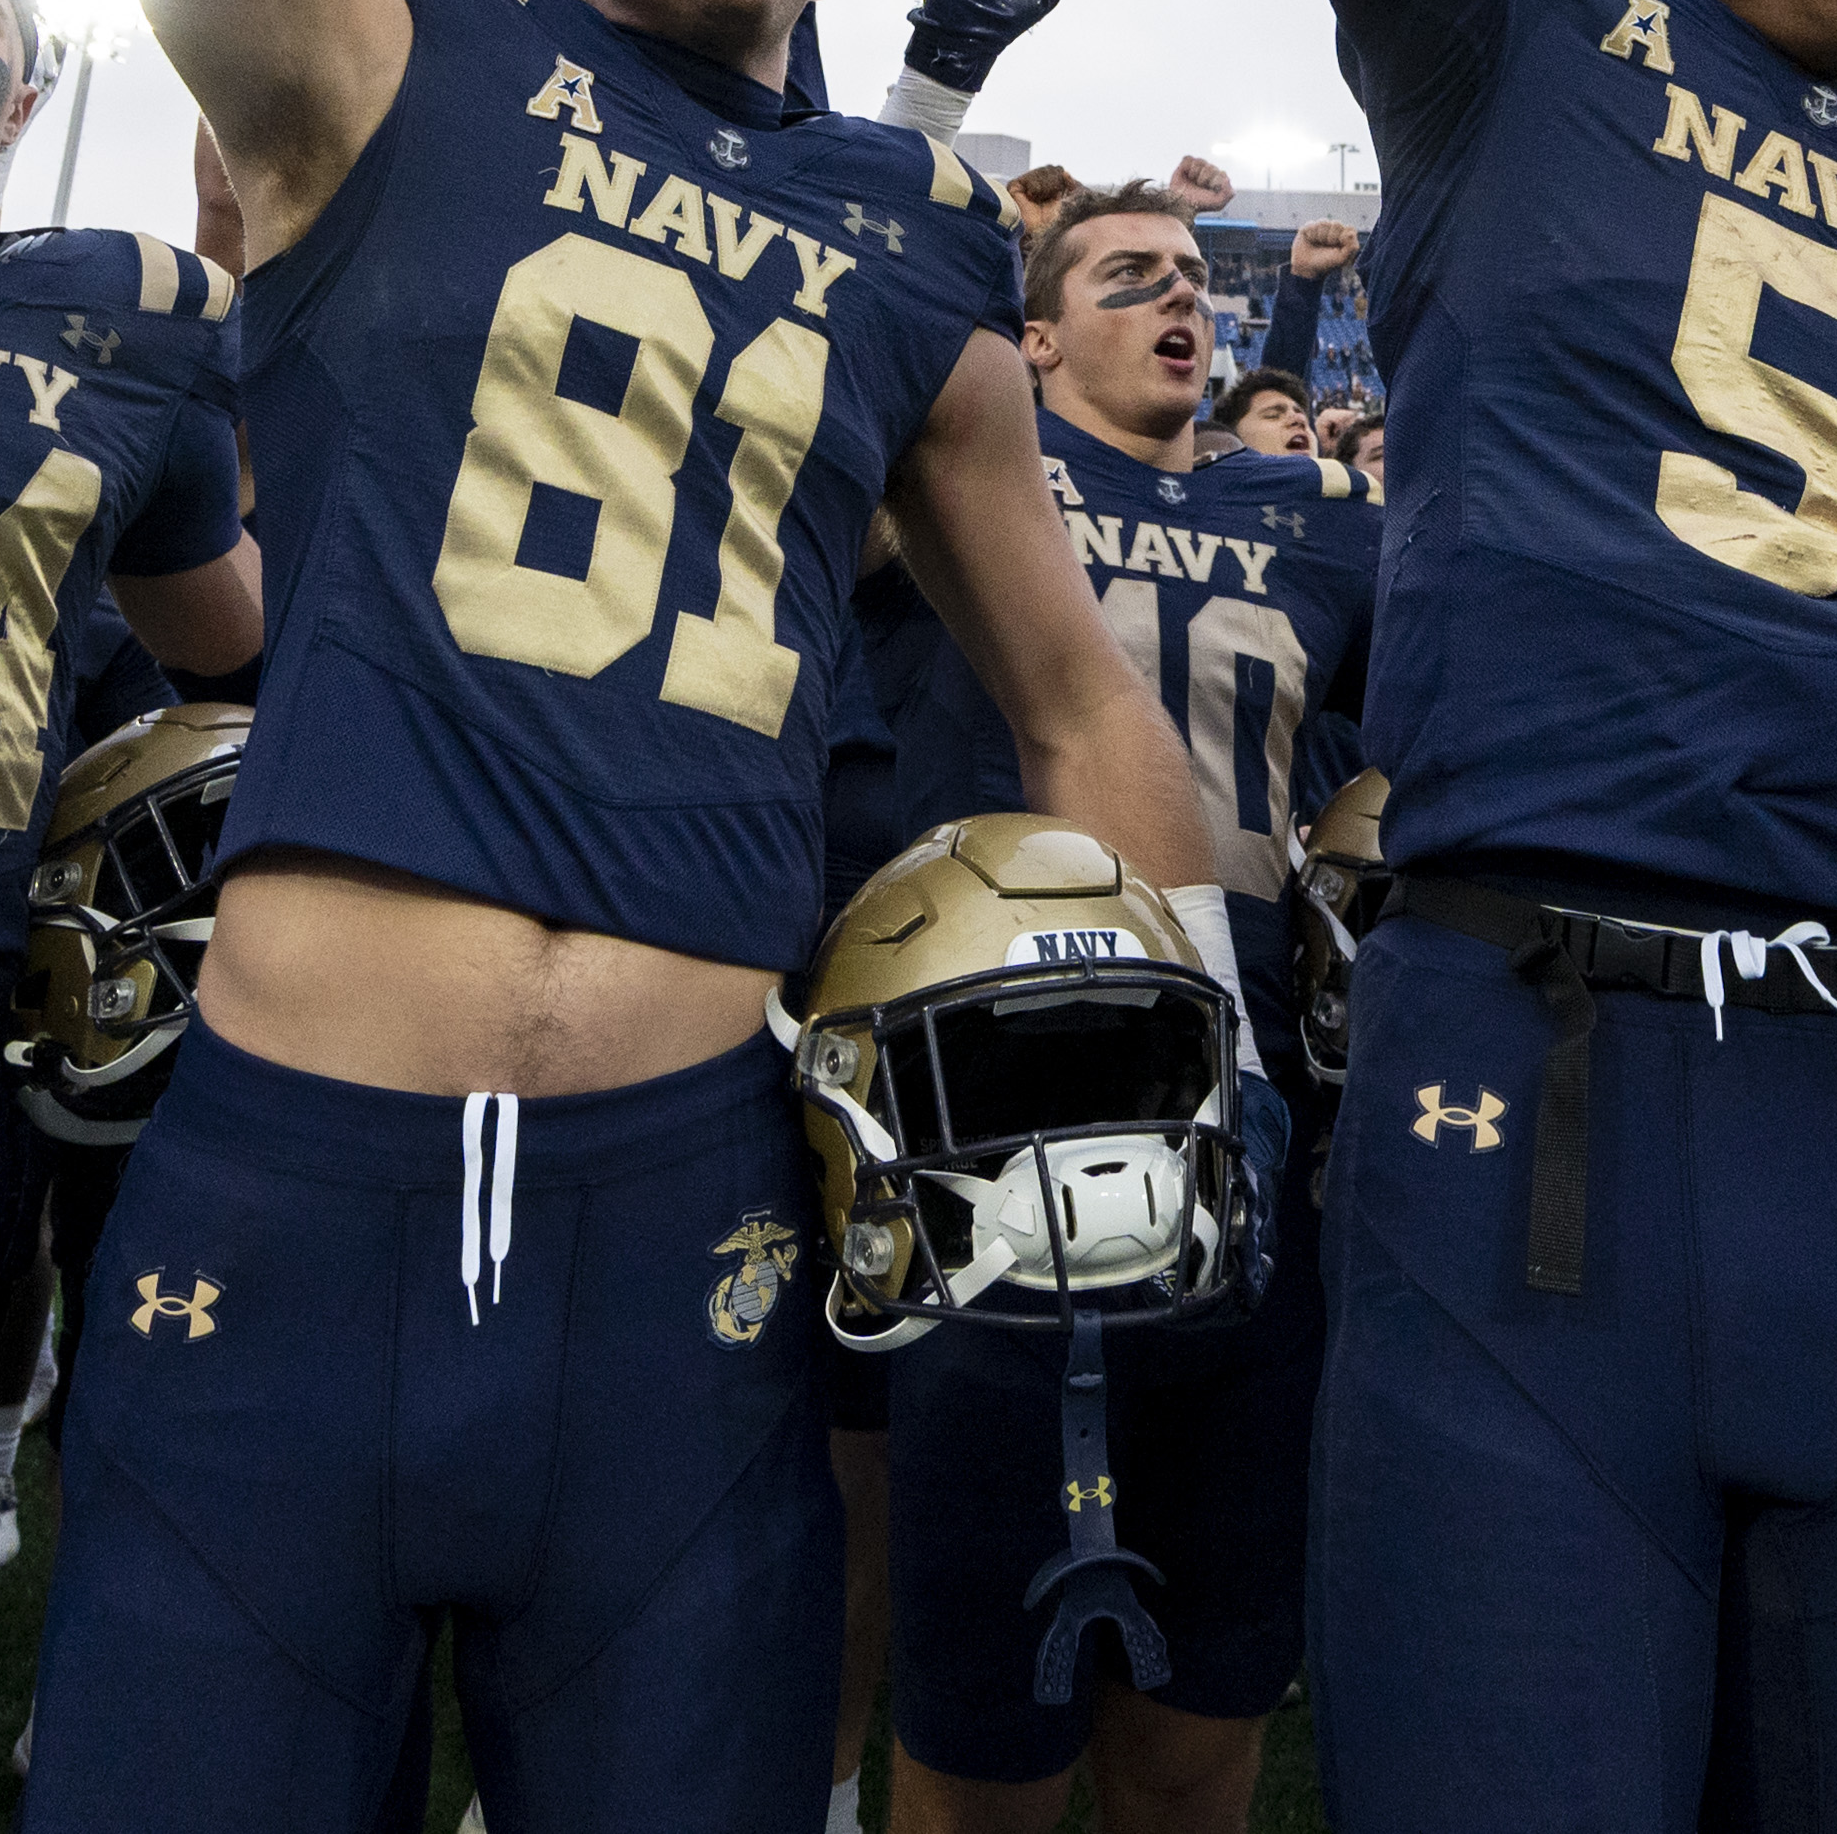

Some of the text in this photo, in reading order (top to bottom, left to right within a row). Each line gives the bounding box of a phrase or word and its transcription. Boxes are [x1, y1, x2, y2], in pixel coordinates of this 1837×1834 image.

[526, 53, 603, 134] A
[543, 132, 857, 318] NAVY
[432, 232, 829, 739] 81
[1064, 510, 1277, 595] NAVY
[1032, 930, 1118, 965] NAVY
